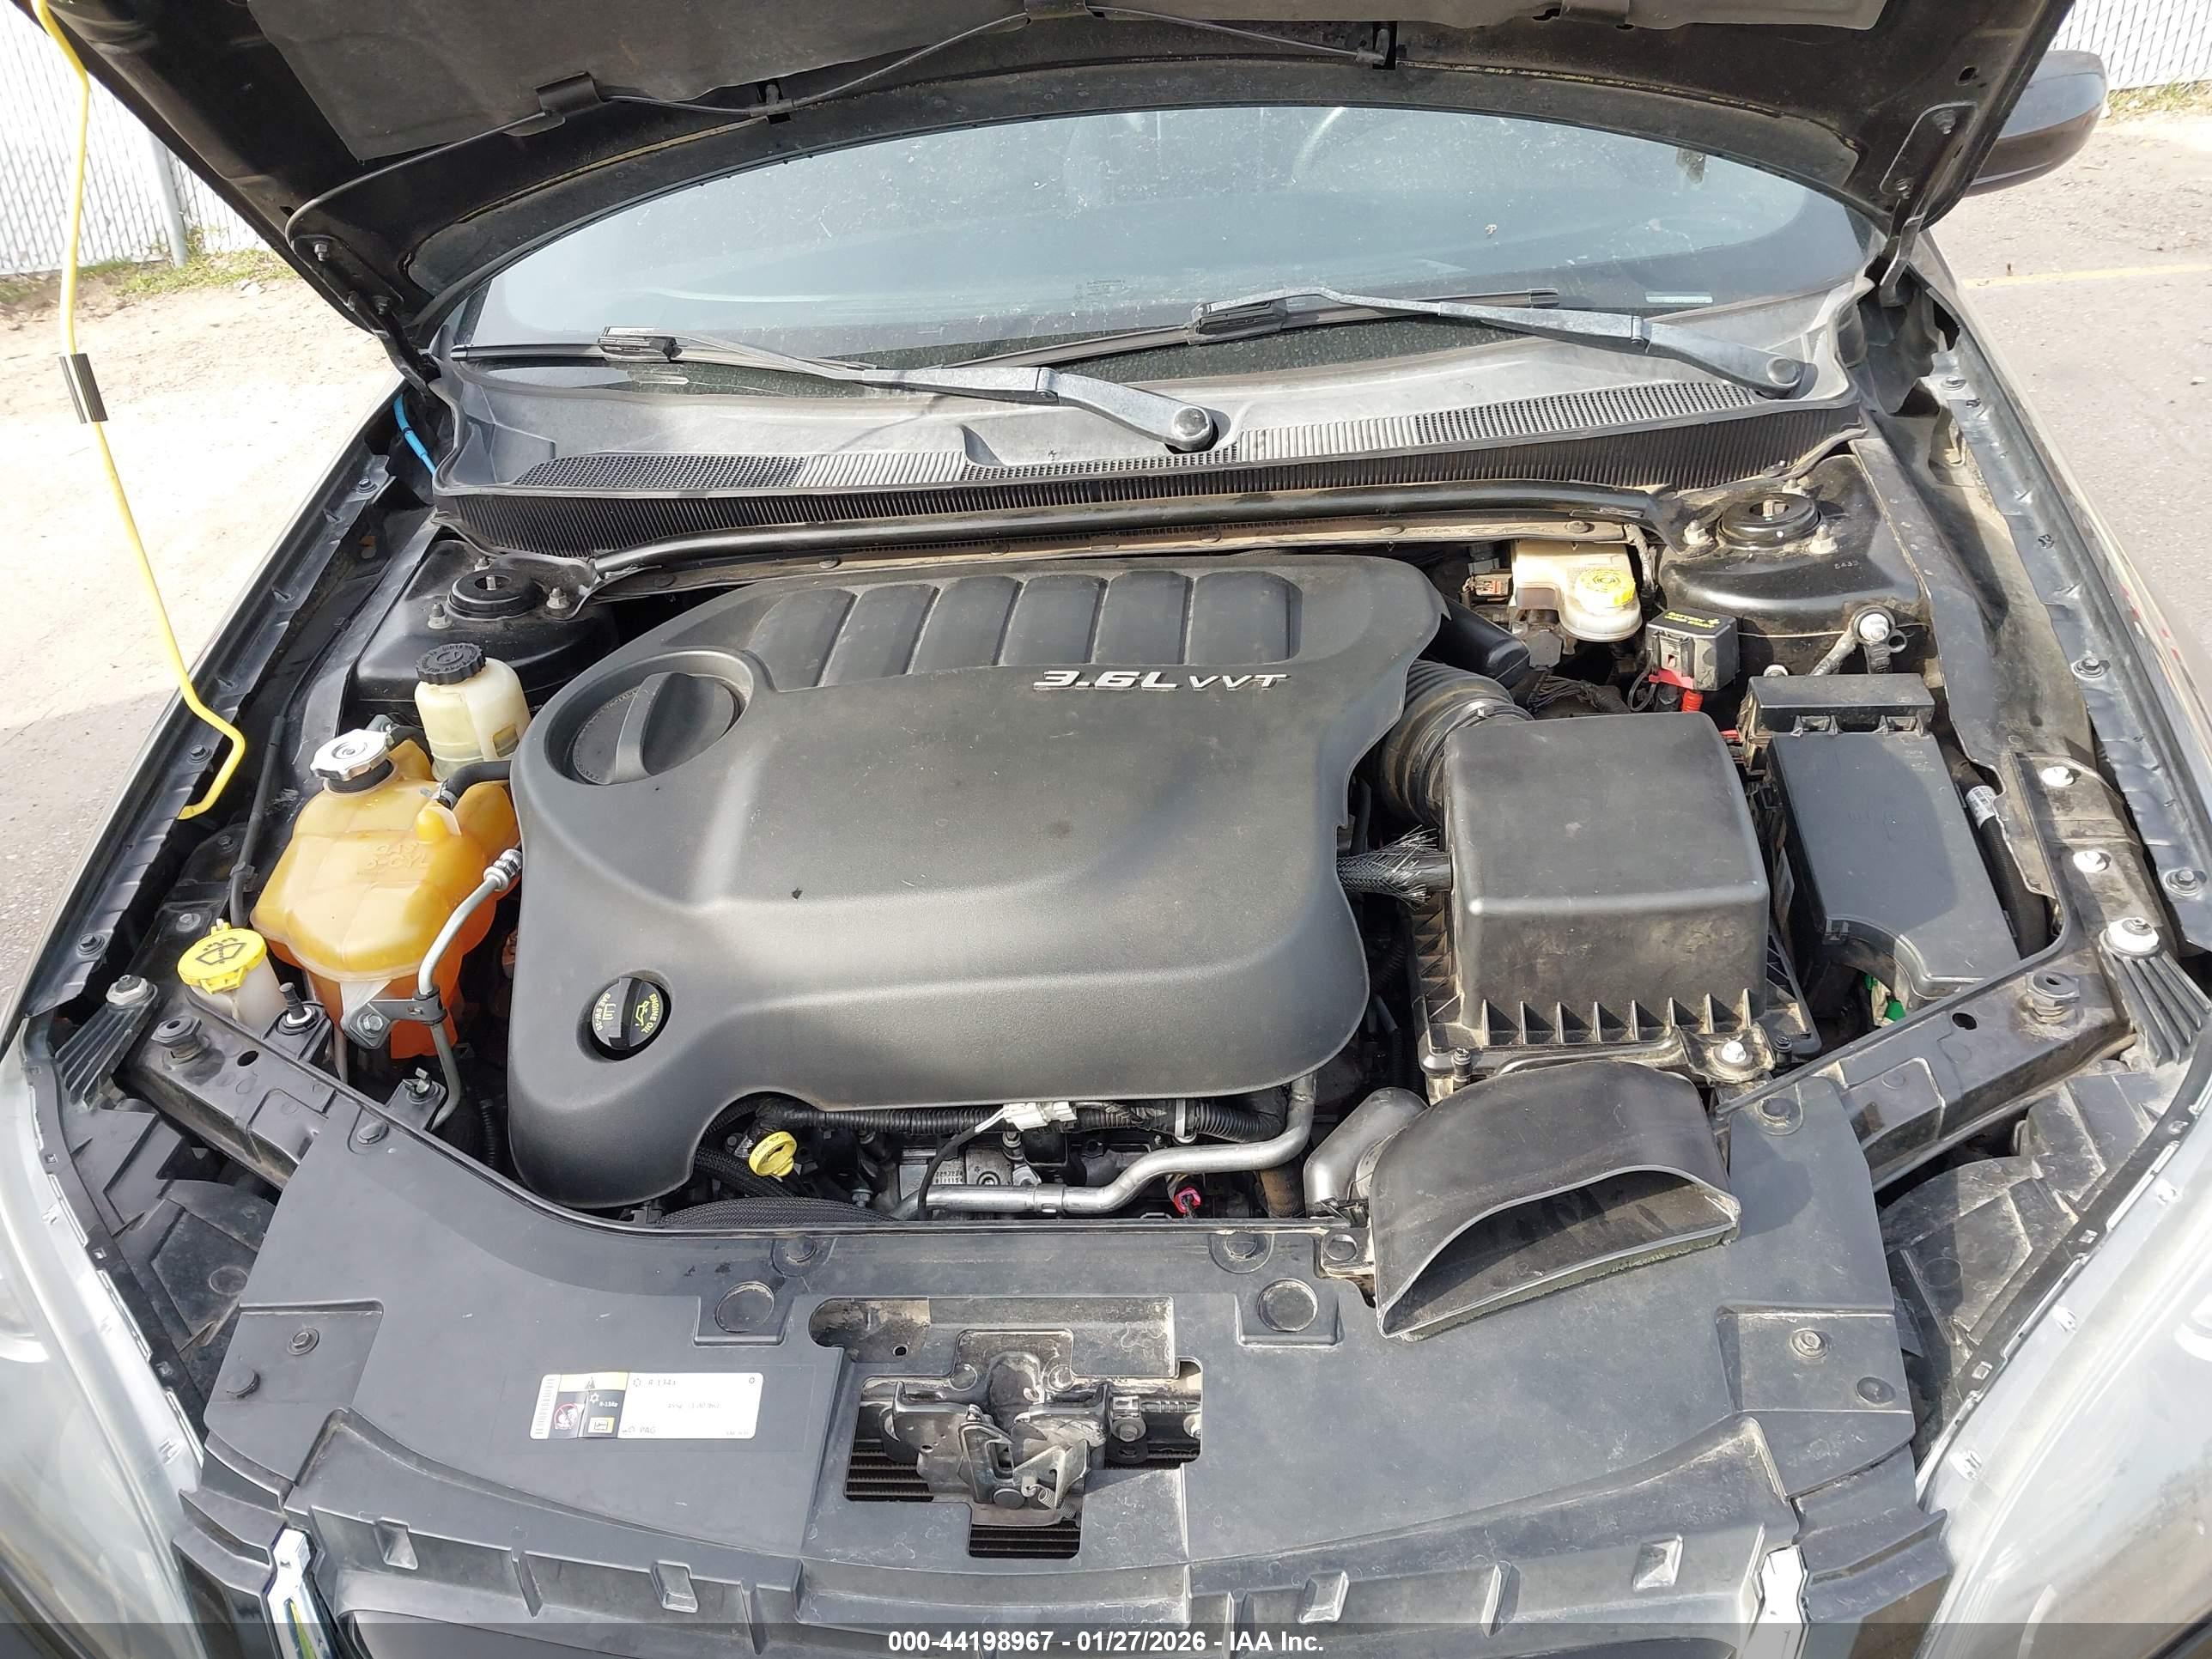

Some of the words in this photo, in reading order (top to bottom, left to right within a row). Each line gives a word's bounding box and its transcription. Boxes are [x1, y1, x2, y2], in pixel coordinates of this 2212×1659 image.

[1033, 671, 1178, 690] 3.6L
[1188, 674, 1287, 690] VVT
[599, 993, 611, 1007] SAE
[649, 994, 659, 1022] ENGINE
[641, 1019, 653, 1034] OIL
[640, 1426, 657, 1435] PAG
